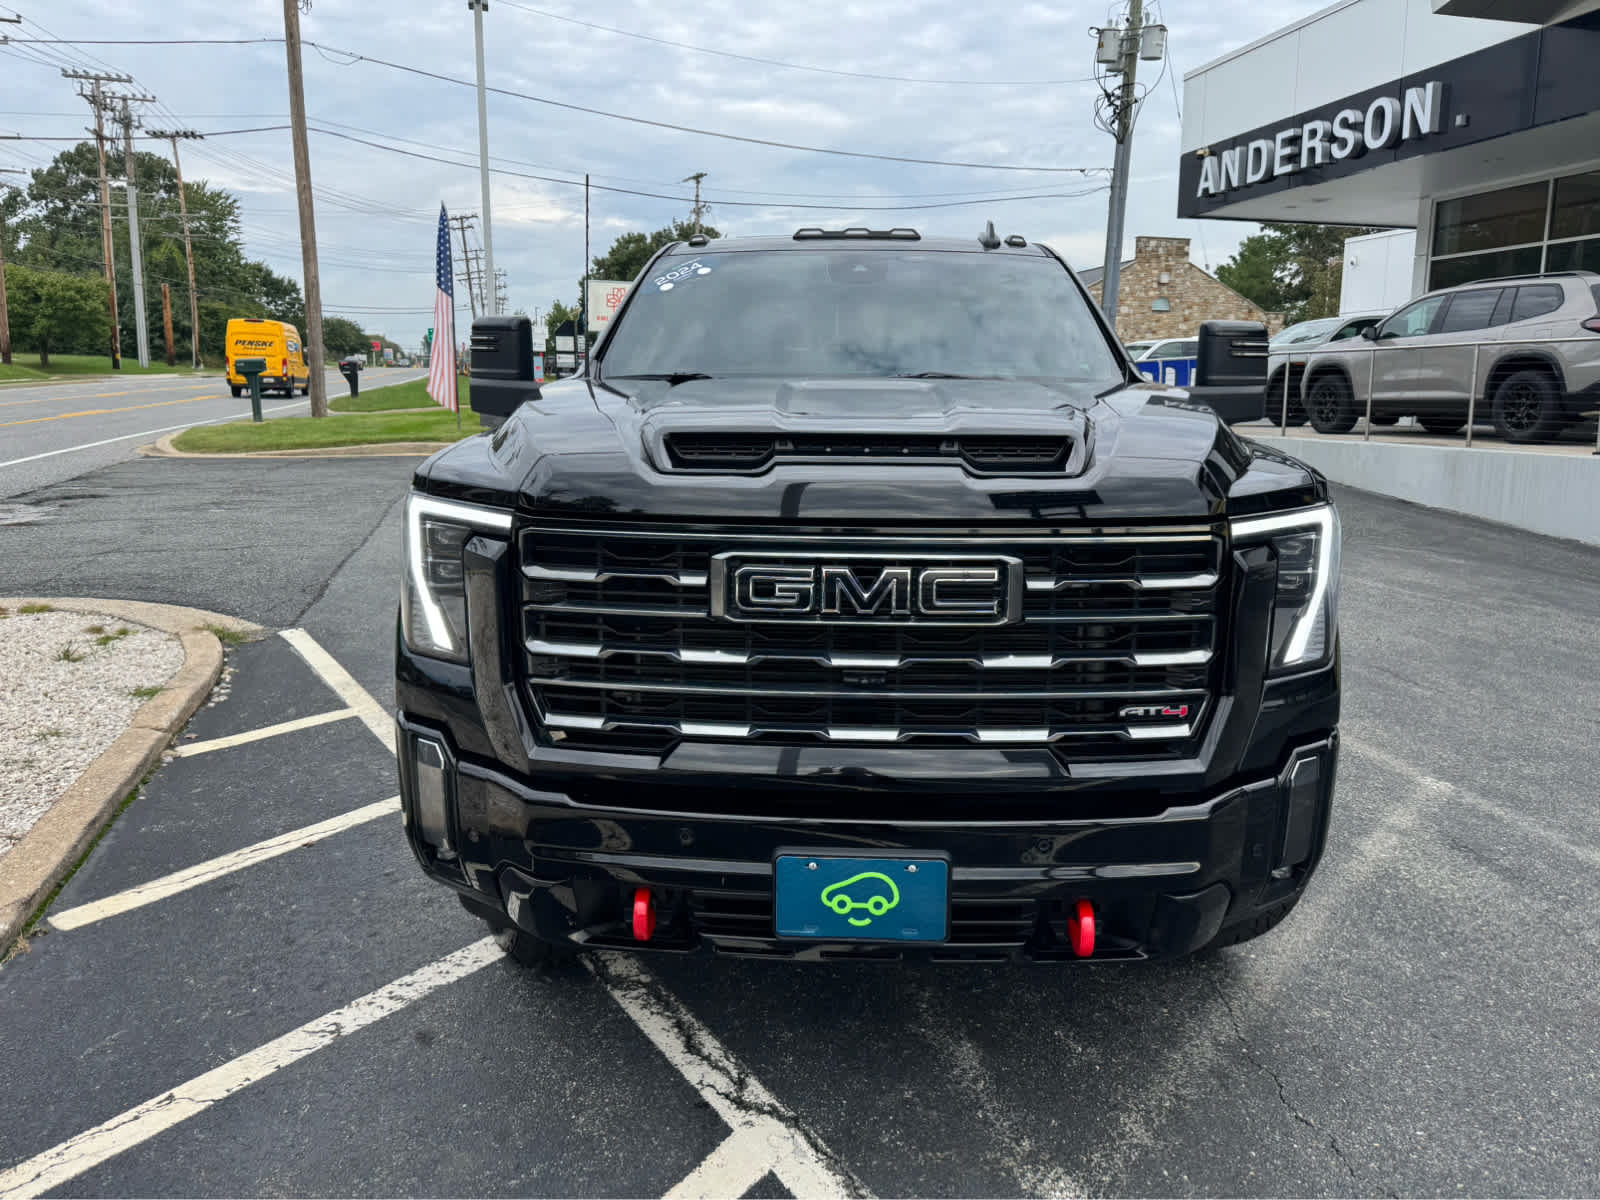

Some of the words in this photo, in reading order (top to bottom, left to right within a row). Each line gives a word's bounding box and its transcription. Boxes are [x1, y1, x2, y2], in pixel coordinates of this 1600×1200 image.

[654, 262, 703, 286] 2024
[235, 339, 275, 347] PENSKE
[734, 565, 1000, 615] GMC
[1119, 704, 1189, 718] AT4
